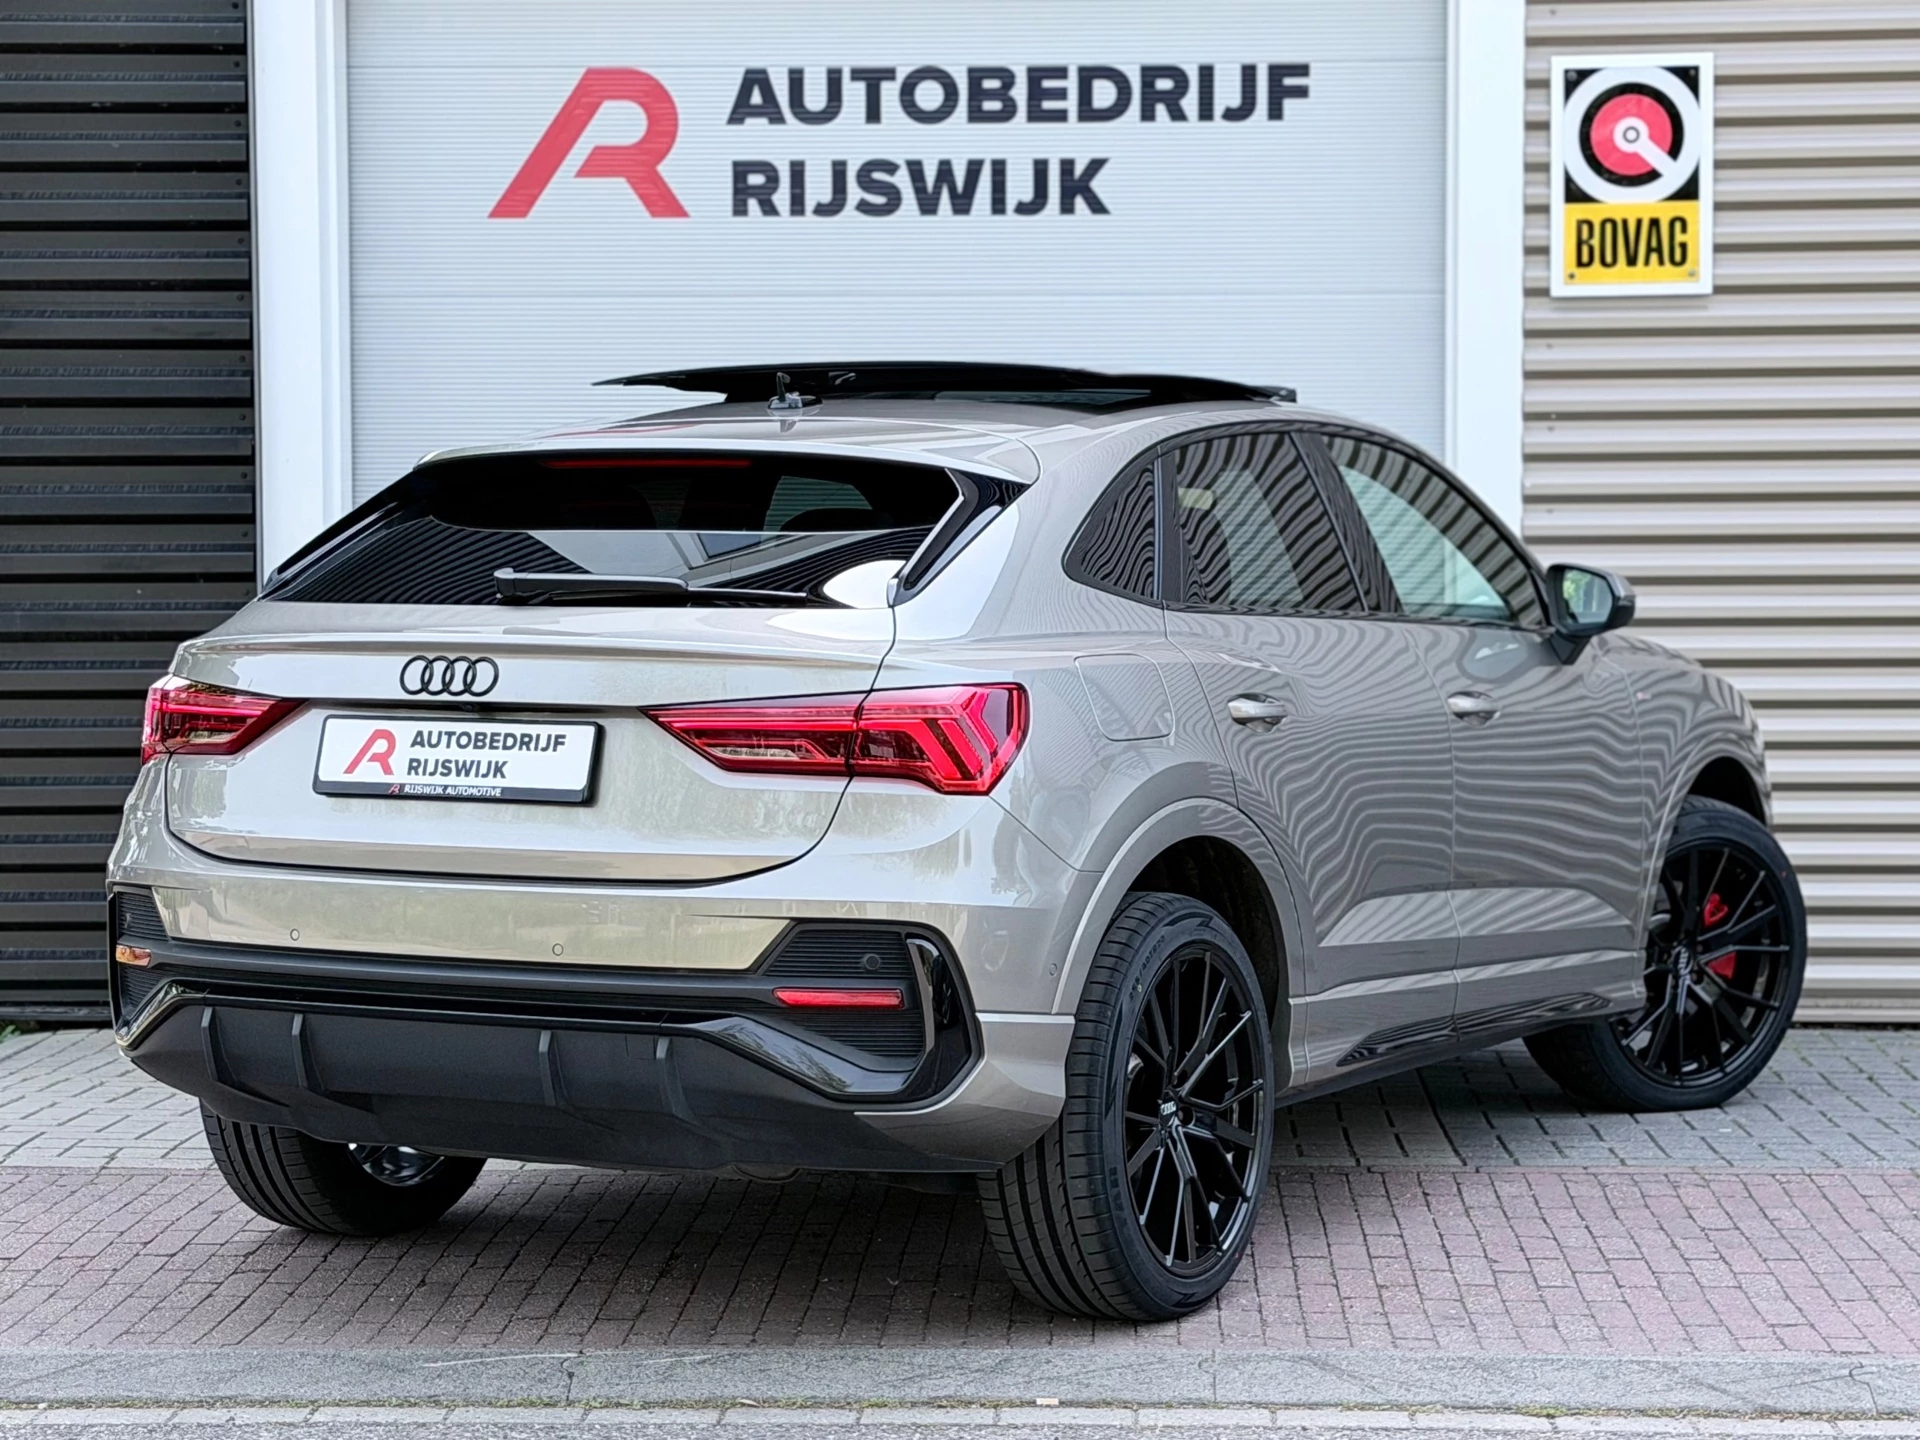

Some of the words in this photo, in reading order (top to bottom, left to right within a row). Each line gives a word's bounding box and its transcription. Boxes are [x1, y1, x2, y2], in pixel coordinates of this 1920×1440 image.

[726, 63, 1311, 126] AUTOBEDRIJF
[730, 158, 1112, 218] RIJSWIJK
[1575, 216, 1688, 268] BOVAG
[410, 730, 567, 753] AUTOBEDRIJF
[406, 757, 508, 779] RIJSWIJK
[403, 784, 444, 795] RIJSWIJK
[445, 786, 503, 797] AUTOMOTIVE
